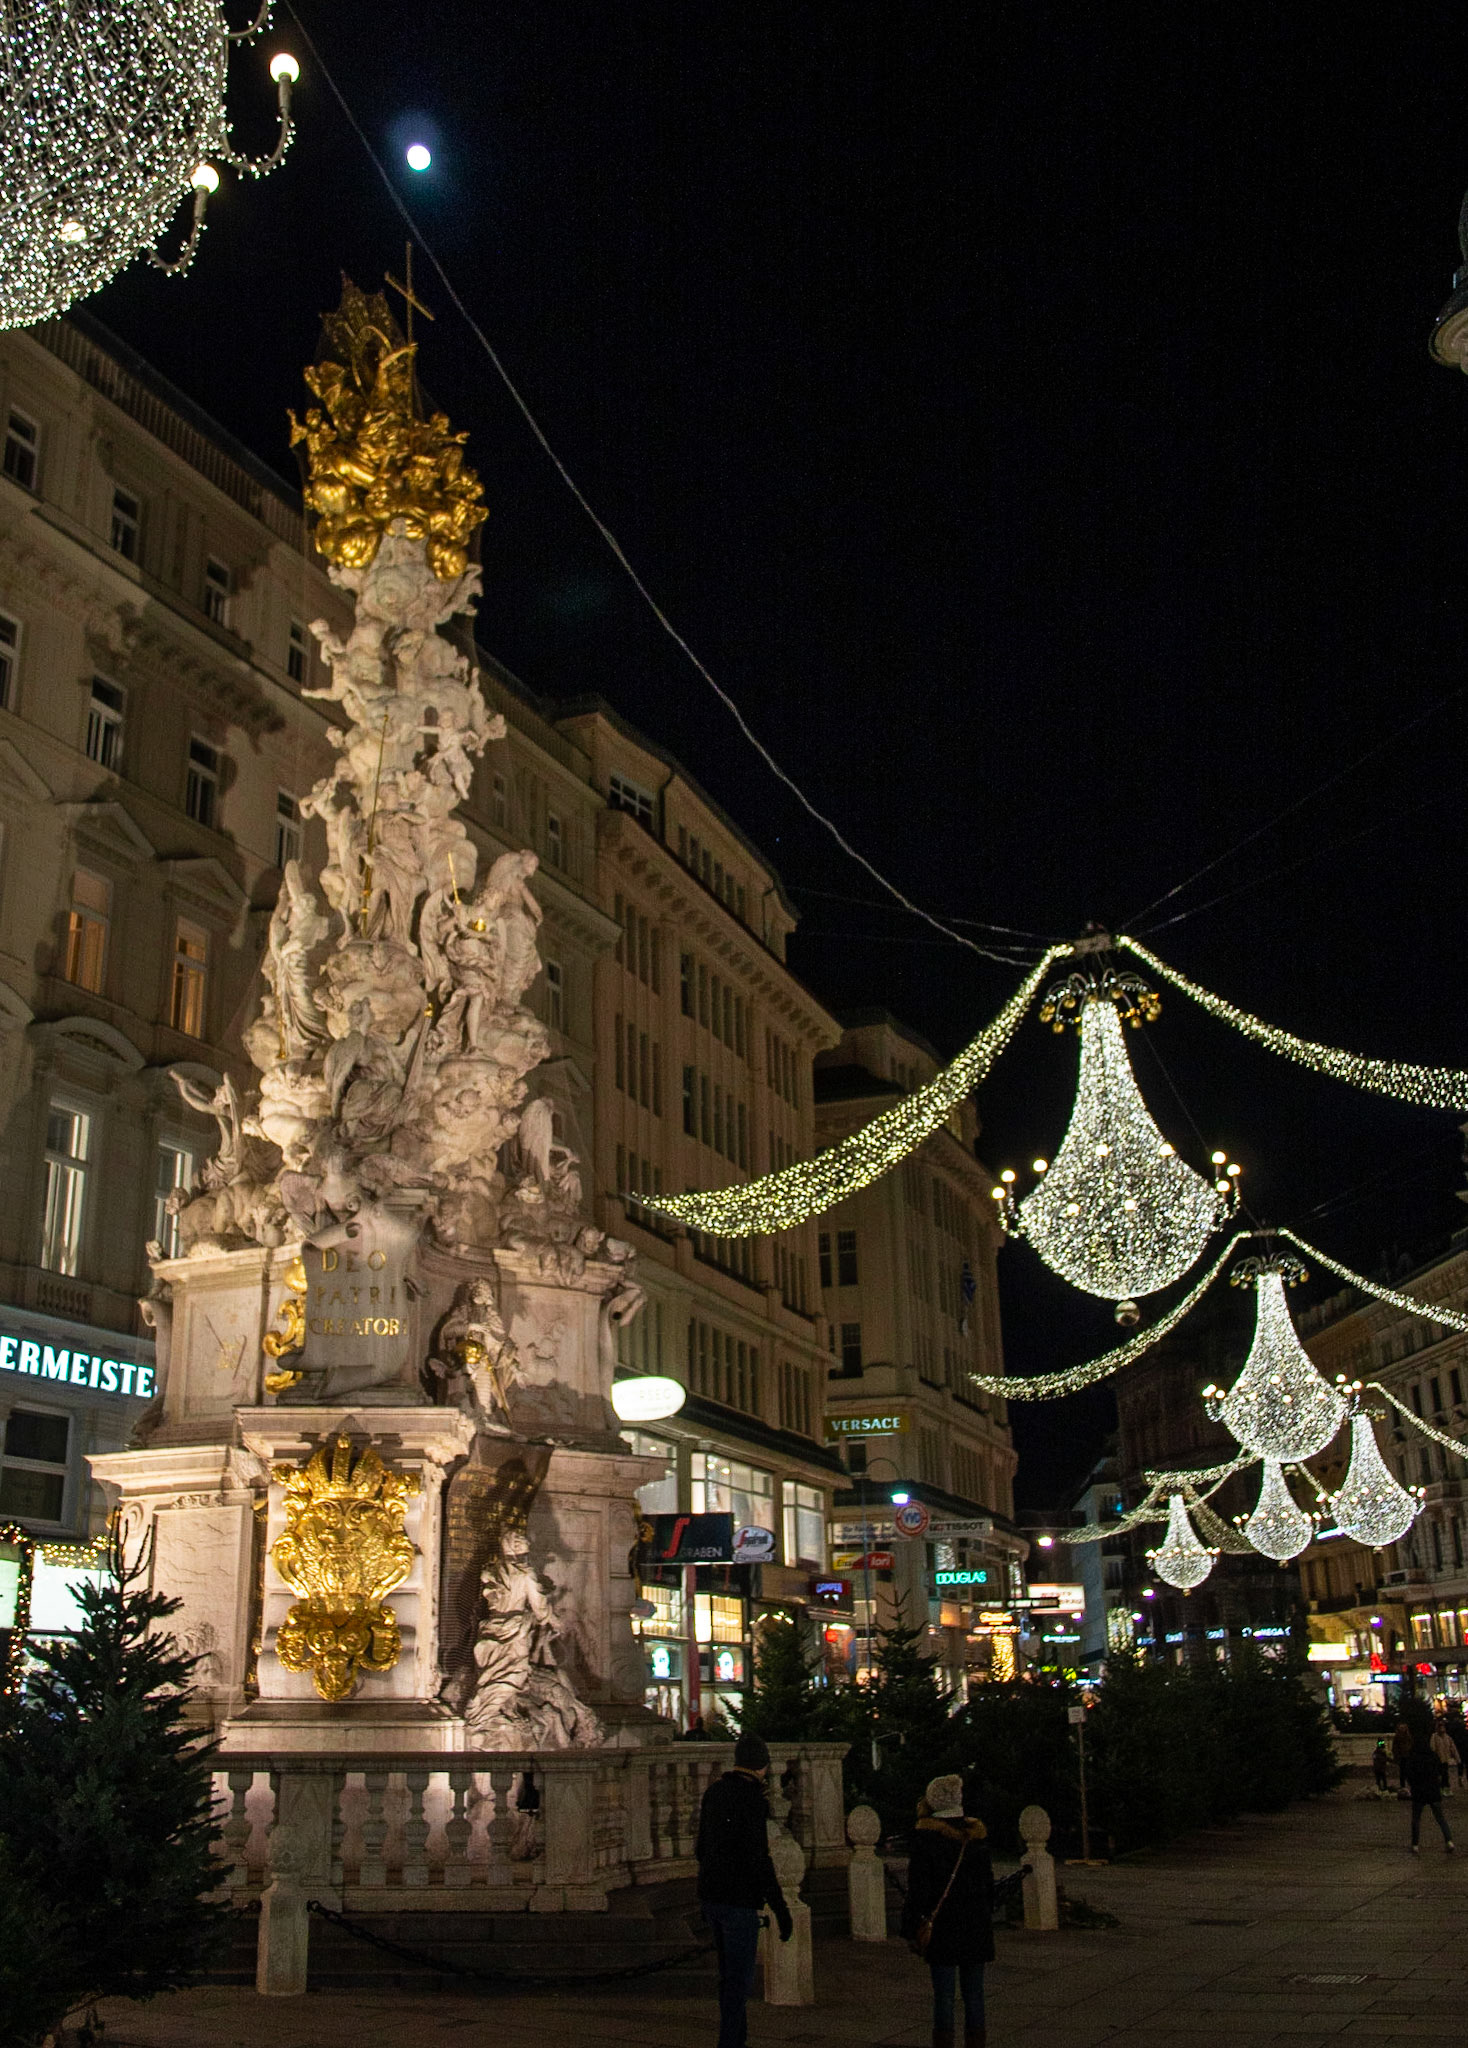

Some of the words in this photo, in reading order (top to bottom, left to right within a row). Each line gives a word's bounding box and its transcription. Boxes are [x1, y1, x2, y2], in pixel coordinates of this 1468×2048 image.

[322, 1247, 387, 1273] DEO
[315, 1286, 397, 1306] PATRI
[0, 1335, 159, 1398] ERMEISTE
[831, 1416, 901, 1432] VERSACE
[946, 1521, 985, 1531] TISSOT
[679, 1546, 723, 1558] GRABEN
[935, 1570, 986, 1584] DOUGLAS
